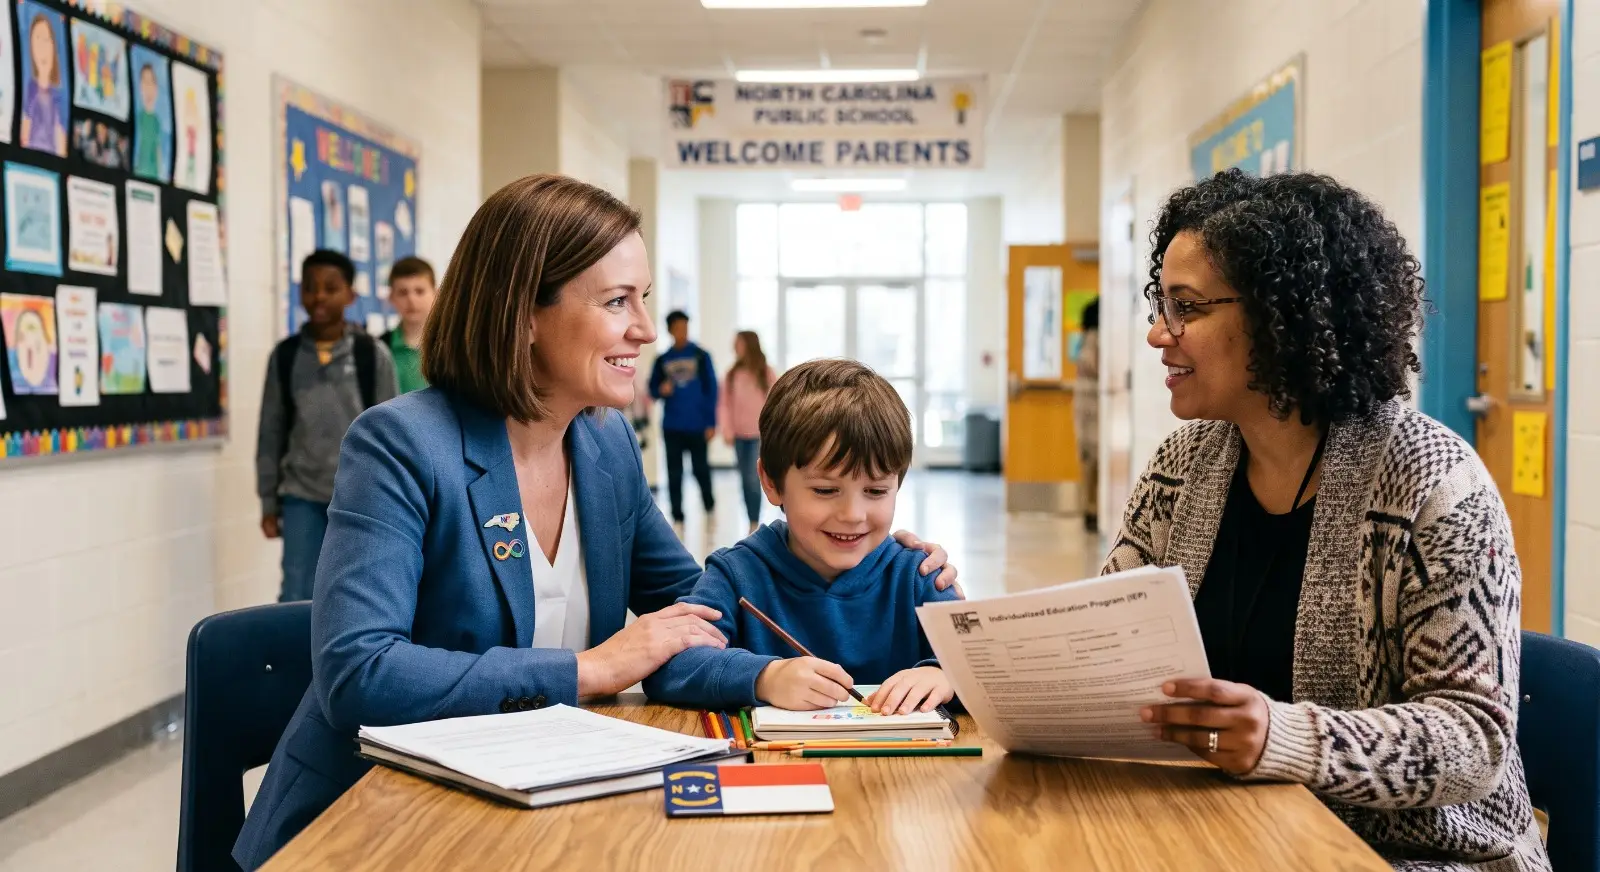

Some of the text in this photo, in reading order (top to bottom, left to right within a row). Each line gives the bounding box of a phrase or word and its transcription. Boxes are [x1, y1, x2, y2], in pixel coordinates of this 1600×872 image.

[734, 84, 814, 102] NORTH
[821, 83, 936, 102] CAROLINA
[753, 108, 917, 125] PUBLIC SCHOOL
[676, 140, 971, 165] WELCOME PARENTS
[988, 608, 1045, 623] Individualized
[1046, 602, 1089, 615] Education
[1089, 596, 1125, 608] Program
[1126, 591, 1148, 603] (IEP)
[671, 783, 717, 794] N C
